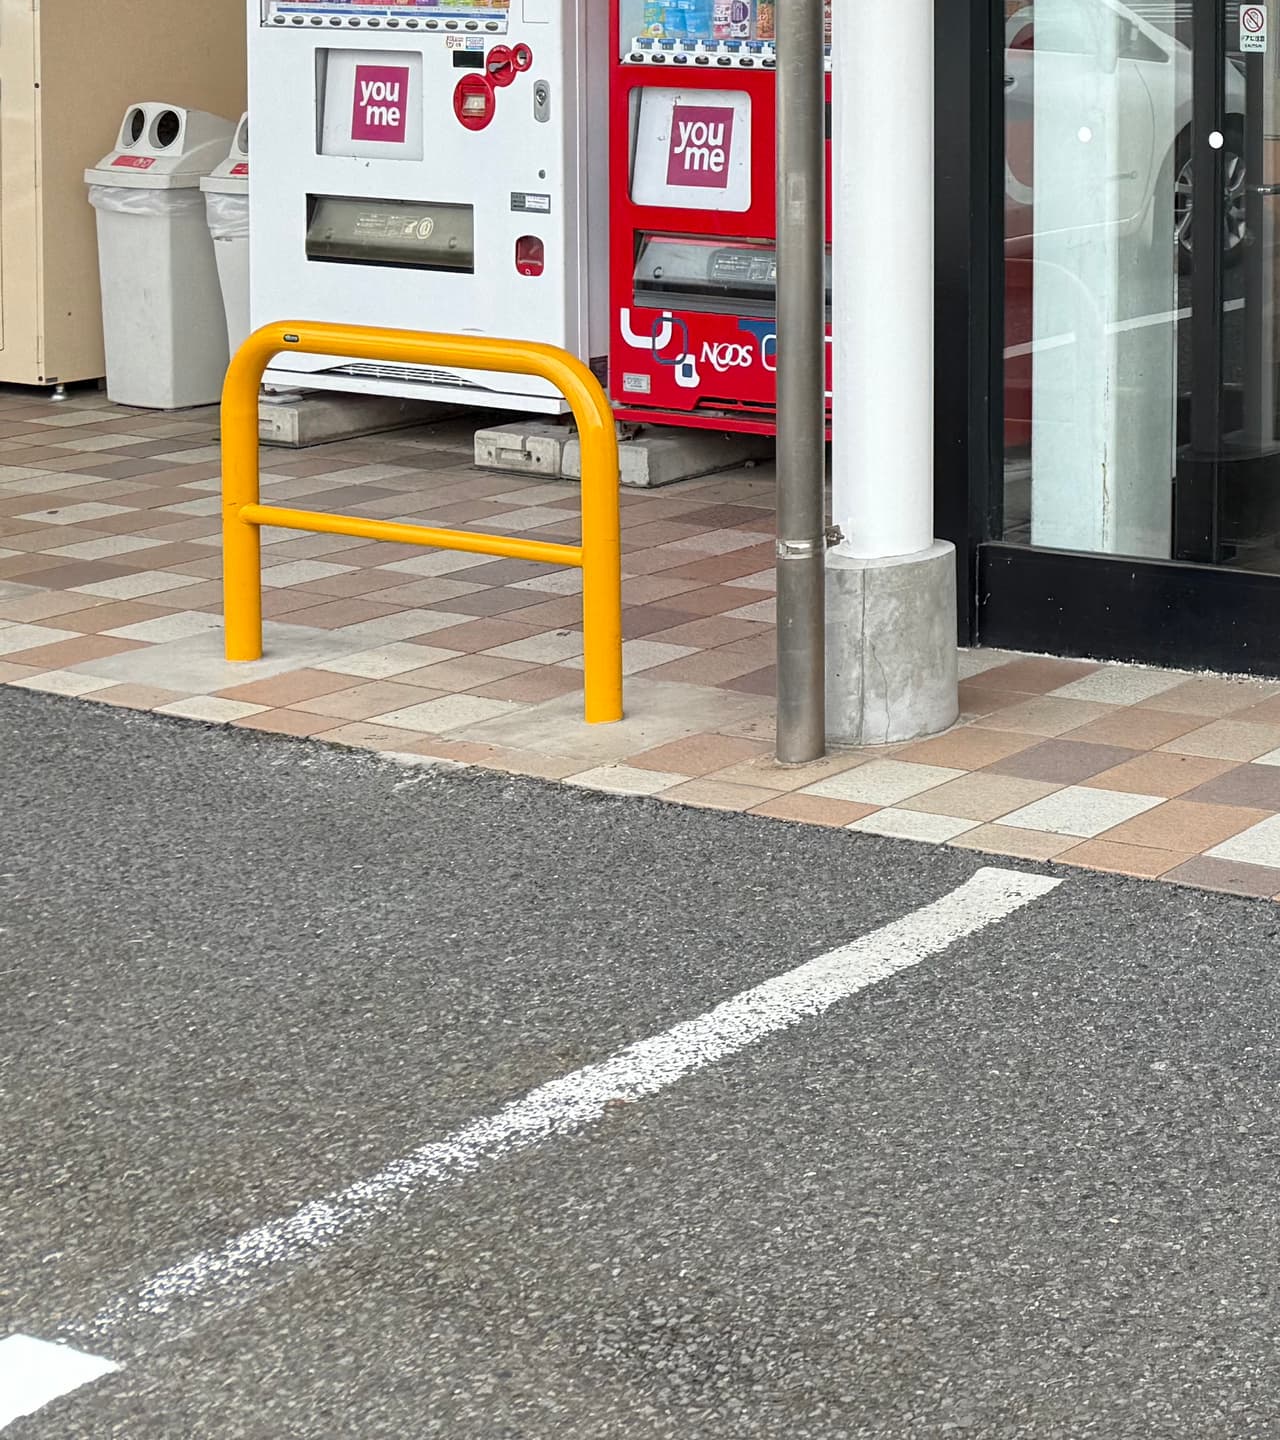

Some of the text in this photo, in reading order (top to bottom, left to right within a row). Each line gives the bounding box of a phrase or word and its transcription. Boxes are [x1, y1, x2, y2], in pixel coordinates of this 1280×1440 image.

[360, 81, 399, 106] you
[366, 107, 400, 126] me
[674, 121, 725, 154] you
[684, 146, 725, 172] me
